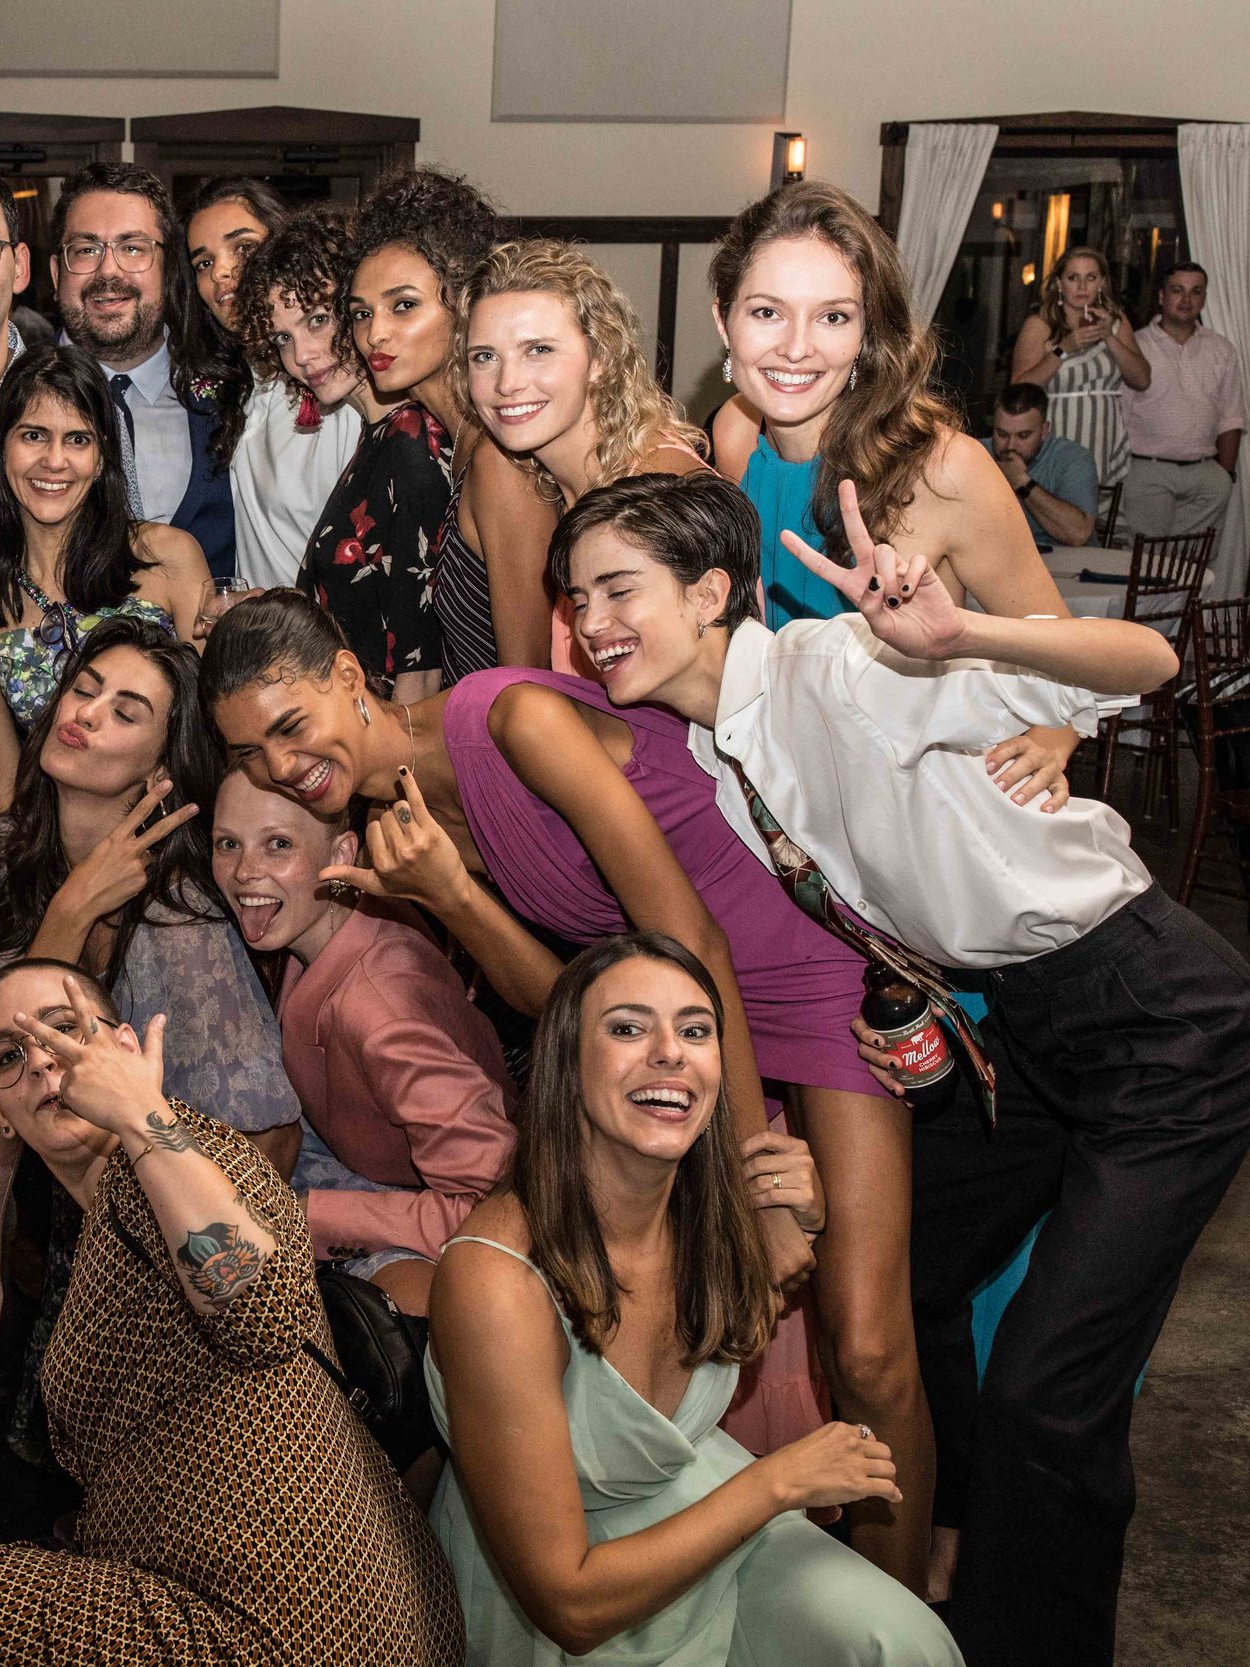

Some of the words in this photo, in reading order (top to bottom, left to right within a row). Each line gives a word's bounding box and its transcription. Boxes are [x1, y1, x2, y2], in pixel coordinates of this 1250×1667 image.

[902, 1036, 940, 1066] Mellow
[919, 1054, 938, 1067] CHERRY
[919, 1057, 942, 1072] HIBISCUS
